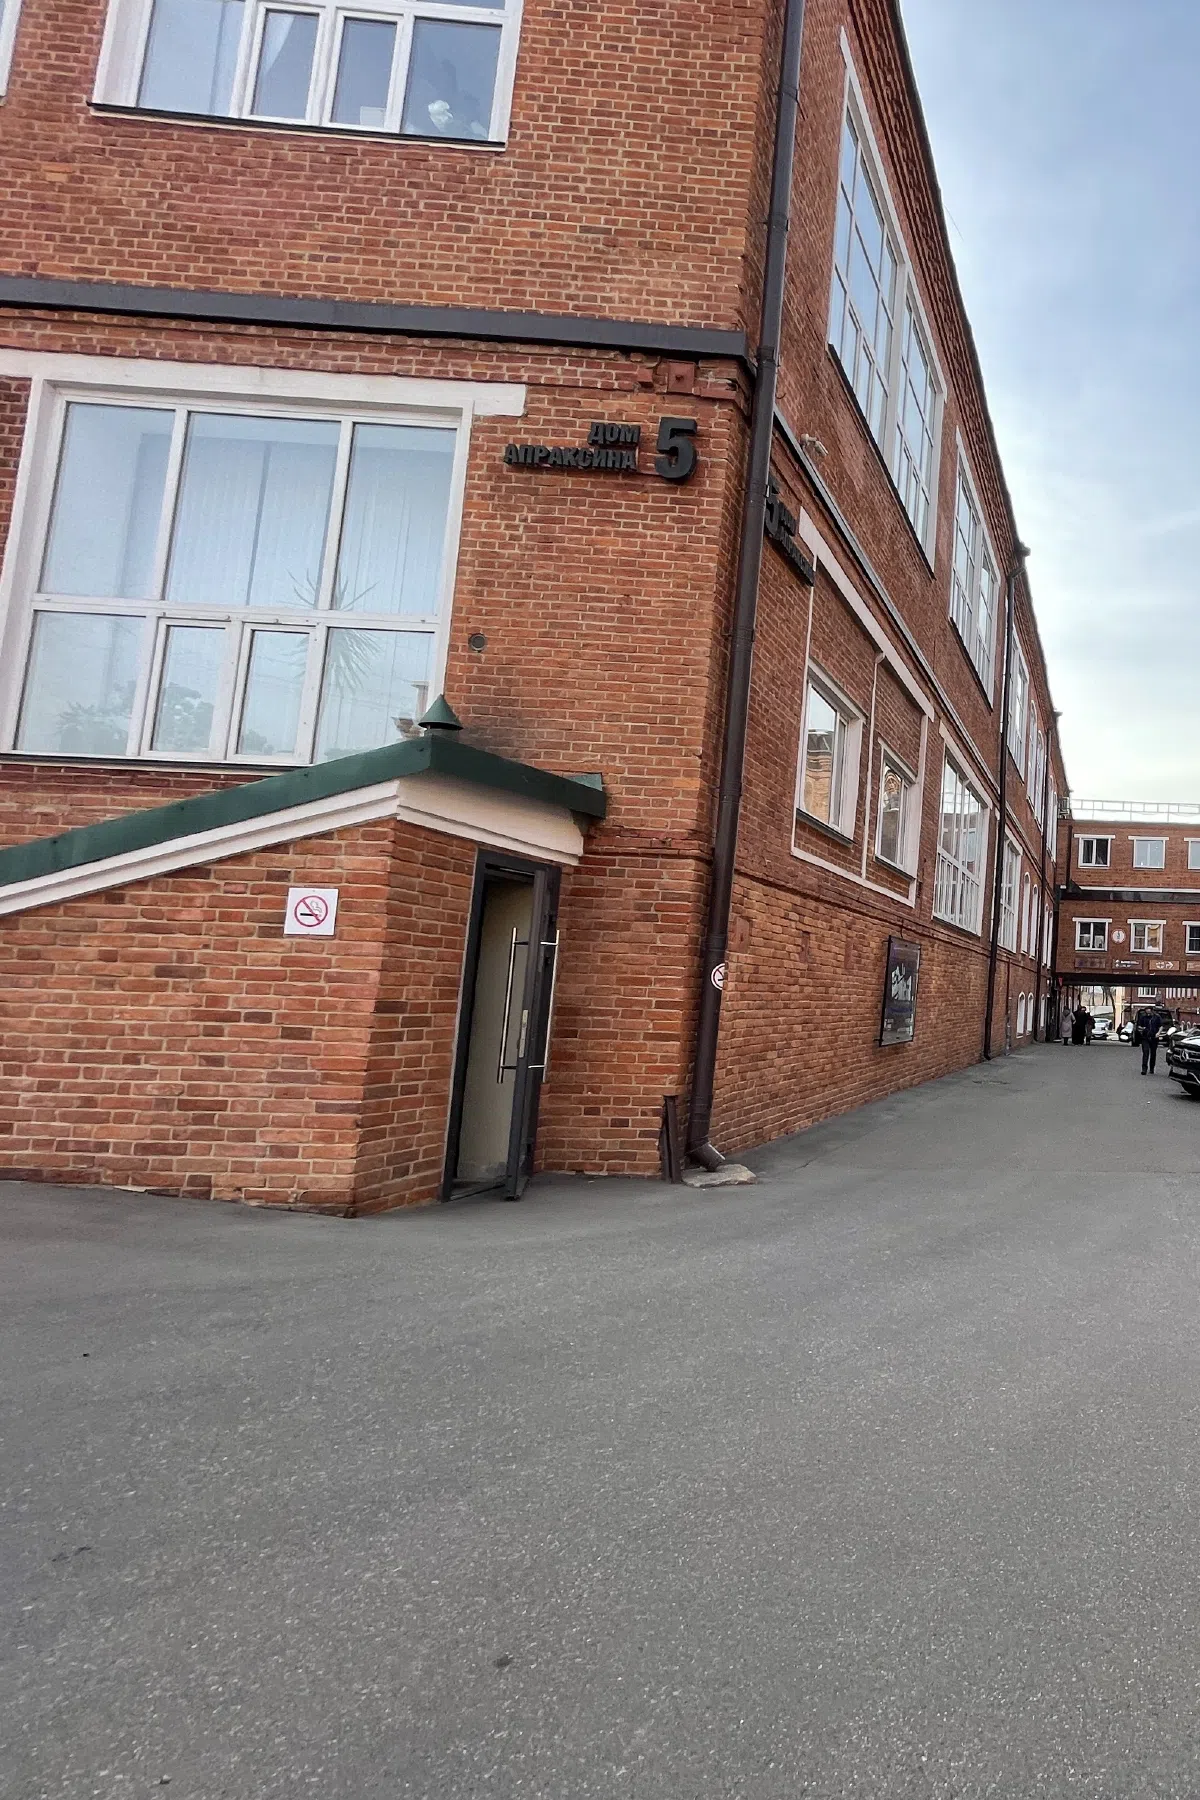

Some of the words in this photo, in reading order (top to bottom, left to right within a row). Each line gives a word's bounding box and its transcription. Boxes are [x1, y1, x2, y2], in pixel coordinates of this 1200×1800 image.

[588, 422, 641, 446] ДОМ
[504, 444, 638, 471] АПРАКСИНА
[655, 417, 697, 483] 5
